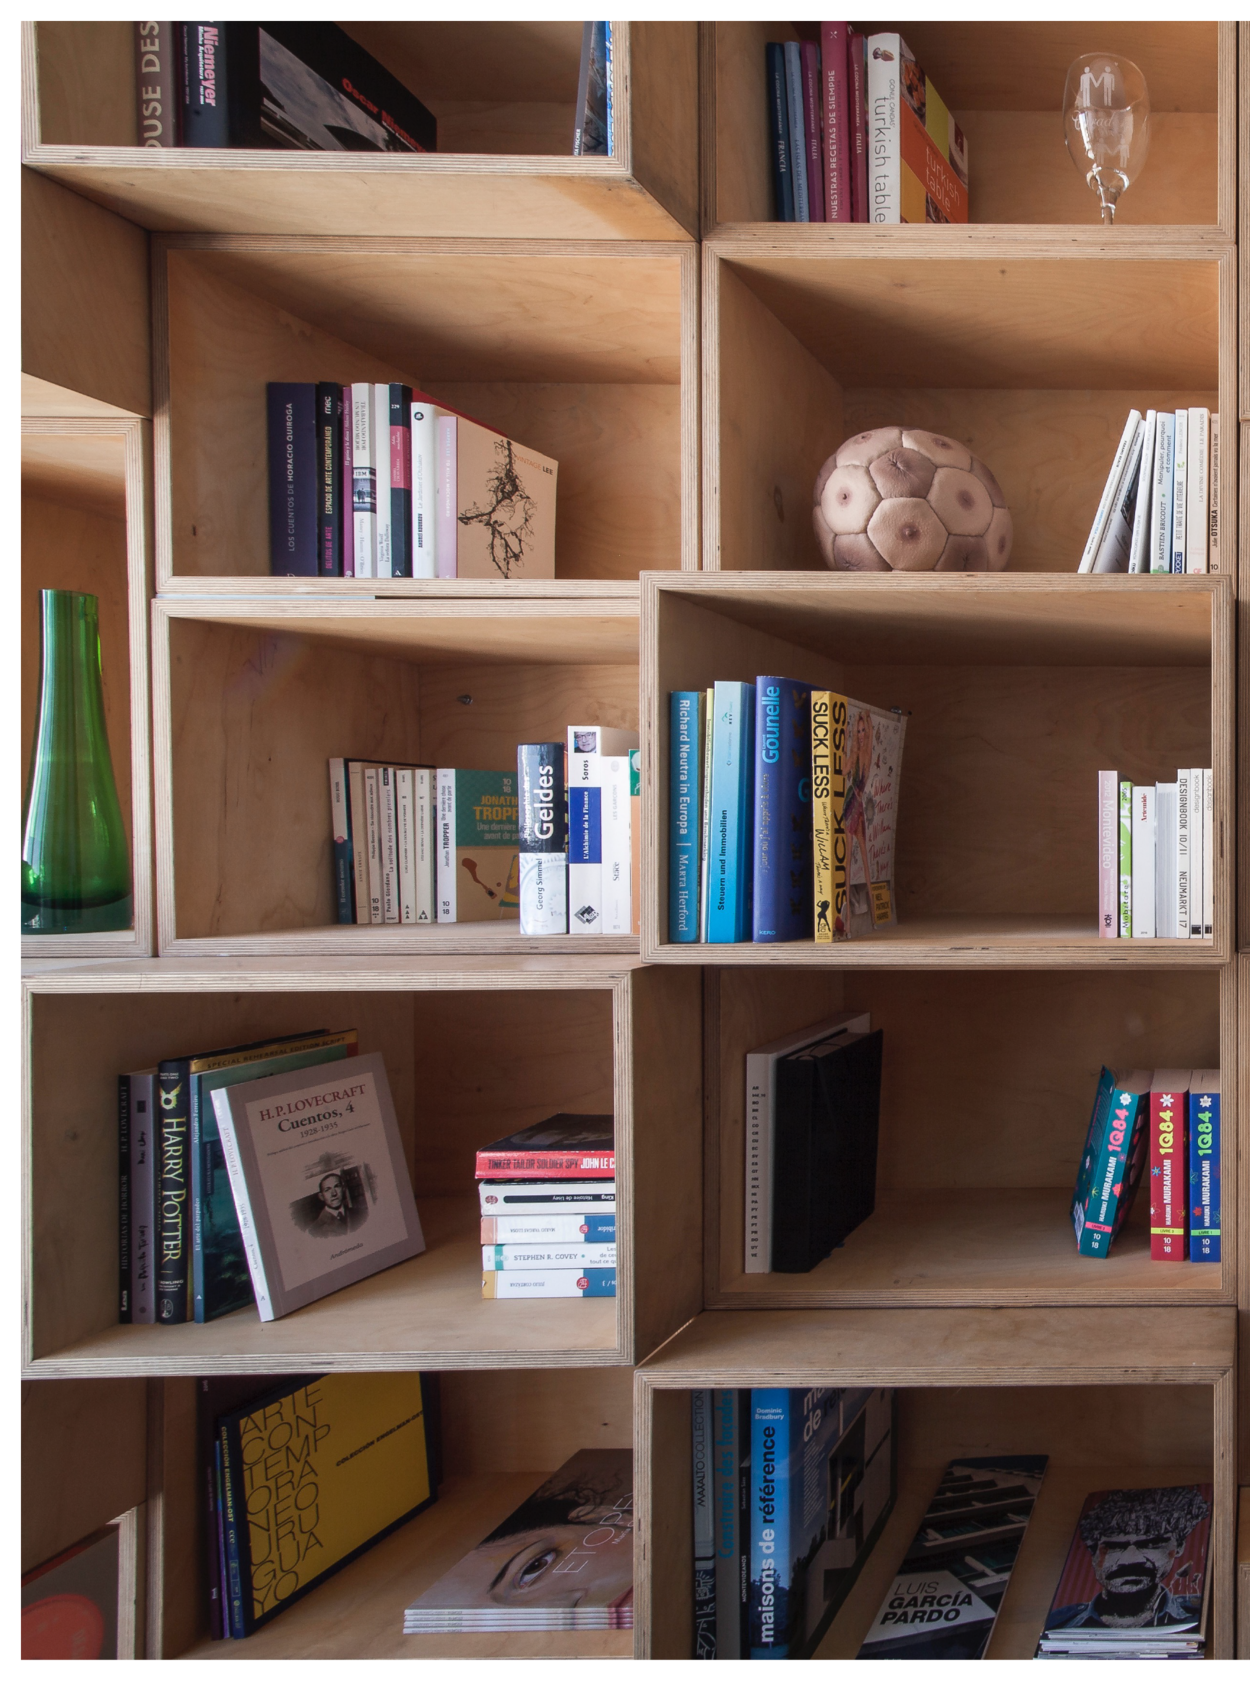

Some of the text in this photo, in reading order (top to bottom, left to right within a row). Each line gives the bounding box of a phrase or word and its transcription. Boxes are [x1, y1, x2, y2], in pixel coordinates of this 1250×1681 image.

[202, 26, 219, 107] Niemeyer
[341, 78, 380, 115] Oscar
[778, 140, 786, 173] FRANCIA
[828, 70, 839, 219] NUESTRAS RECETAS DE SIEMPRE
[874, 96, 892, 223] turkish table
[1157, 420, 1167, 451] pourquoi
[285, 403, 296, 552] LOS CUENTOS DE HORACIO QUIROGA
[542, 466, 554, 476] LEE
[324, 471, 333, 515] ESPACIO ARTE
[1158, 501, 1167, 561] BASTIEN BRICOUT
[1210, 509, 1218, 537] OTSUKA
[761, 686, 782, 764] Gounelle
[581, 759, 590, 781] Soros
[676, 699, 691, 835] Richard Neutra in Europa
[813, 701, 830, 798] SUCK LESS
[533, 765, 555, 841] Geldes
[1140, 793, 1149, 823] Artemide
[1193, 774, 1202, 814] designbook
[1205, 774, 1214, 812] designbook
[442, 822, 450, 850] TROPPER
[582, 821, 589, 829] de
[582, 829, 590, 860] L'Alchimie
[1102, 780, 1115, 869] 2012 Montevideo
[717, 809, 729, 911] Steuern und Immobilien
[834, 813, 847, 916] SUCK
[1178, 778, 1189, 929] DESIGNBOOK 10/11 NEUMARKT 17
[384, 872, 392, 897] Giordano
[535, 858, 546, 911] Georg Simmel
[678, 890, 690, 932] Herford
[207, 1056, 242, 1069] SPECIAL
[277, 1100, 355, 1133] Cuentos, 4
[300, 1121, 339, 1138] 1928-1935
[1107, 1108, 1129, 1152] 1Q84
[1158, 1110, 1174, 1155] 1Q84
[1197, 1110, 1213, 1157] 1Q84
[487, 1158, 608, 1170] TINKER TAILOR SOLDIER SPY JOHN LE
[1101, 1156, 1117, 1201] MURAKAMI
[1163, 1159, 1172, 1204] MURAKAMI
[1201, 1160, 1211, 1205] MURAKAMI
[162, 1115, 187, 1265] HARRY POTTER
[1099, 1201, 1108, 1222] HARUKI
[513, 1253, 578, 1262] STEPHEN COVEY
[1091, 1241, 1099, 1249] 18
[1201, 1247, 1210, 1255] 18
[221, 1426, 231, 1467] COLECCIÓN
[694, 1390, 706, 1508] MAXALTO COLLECTION
[715, 1390, 738, 1559] Construire des façades
[757, 1426, 776, 1643] maisons de référence
[887, 1590, 973, 1610] GARCÍA
[893, 1580, 940, 1596] LUIS
[879, 1607, 961, 1625] PARDO
